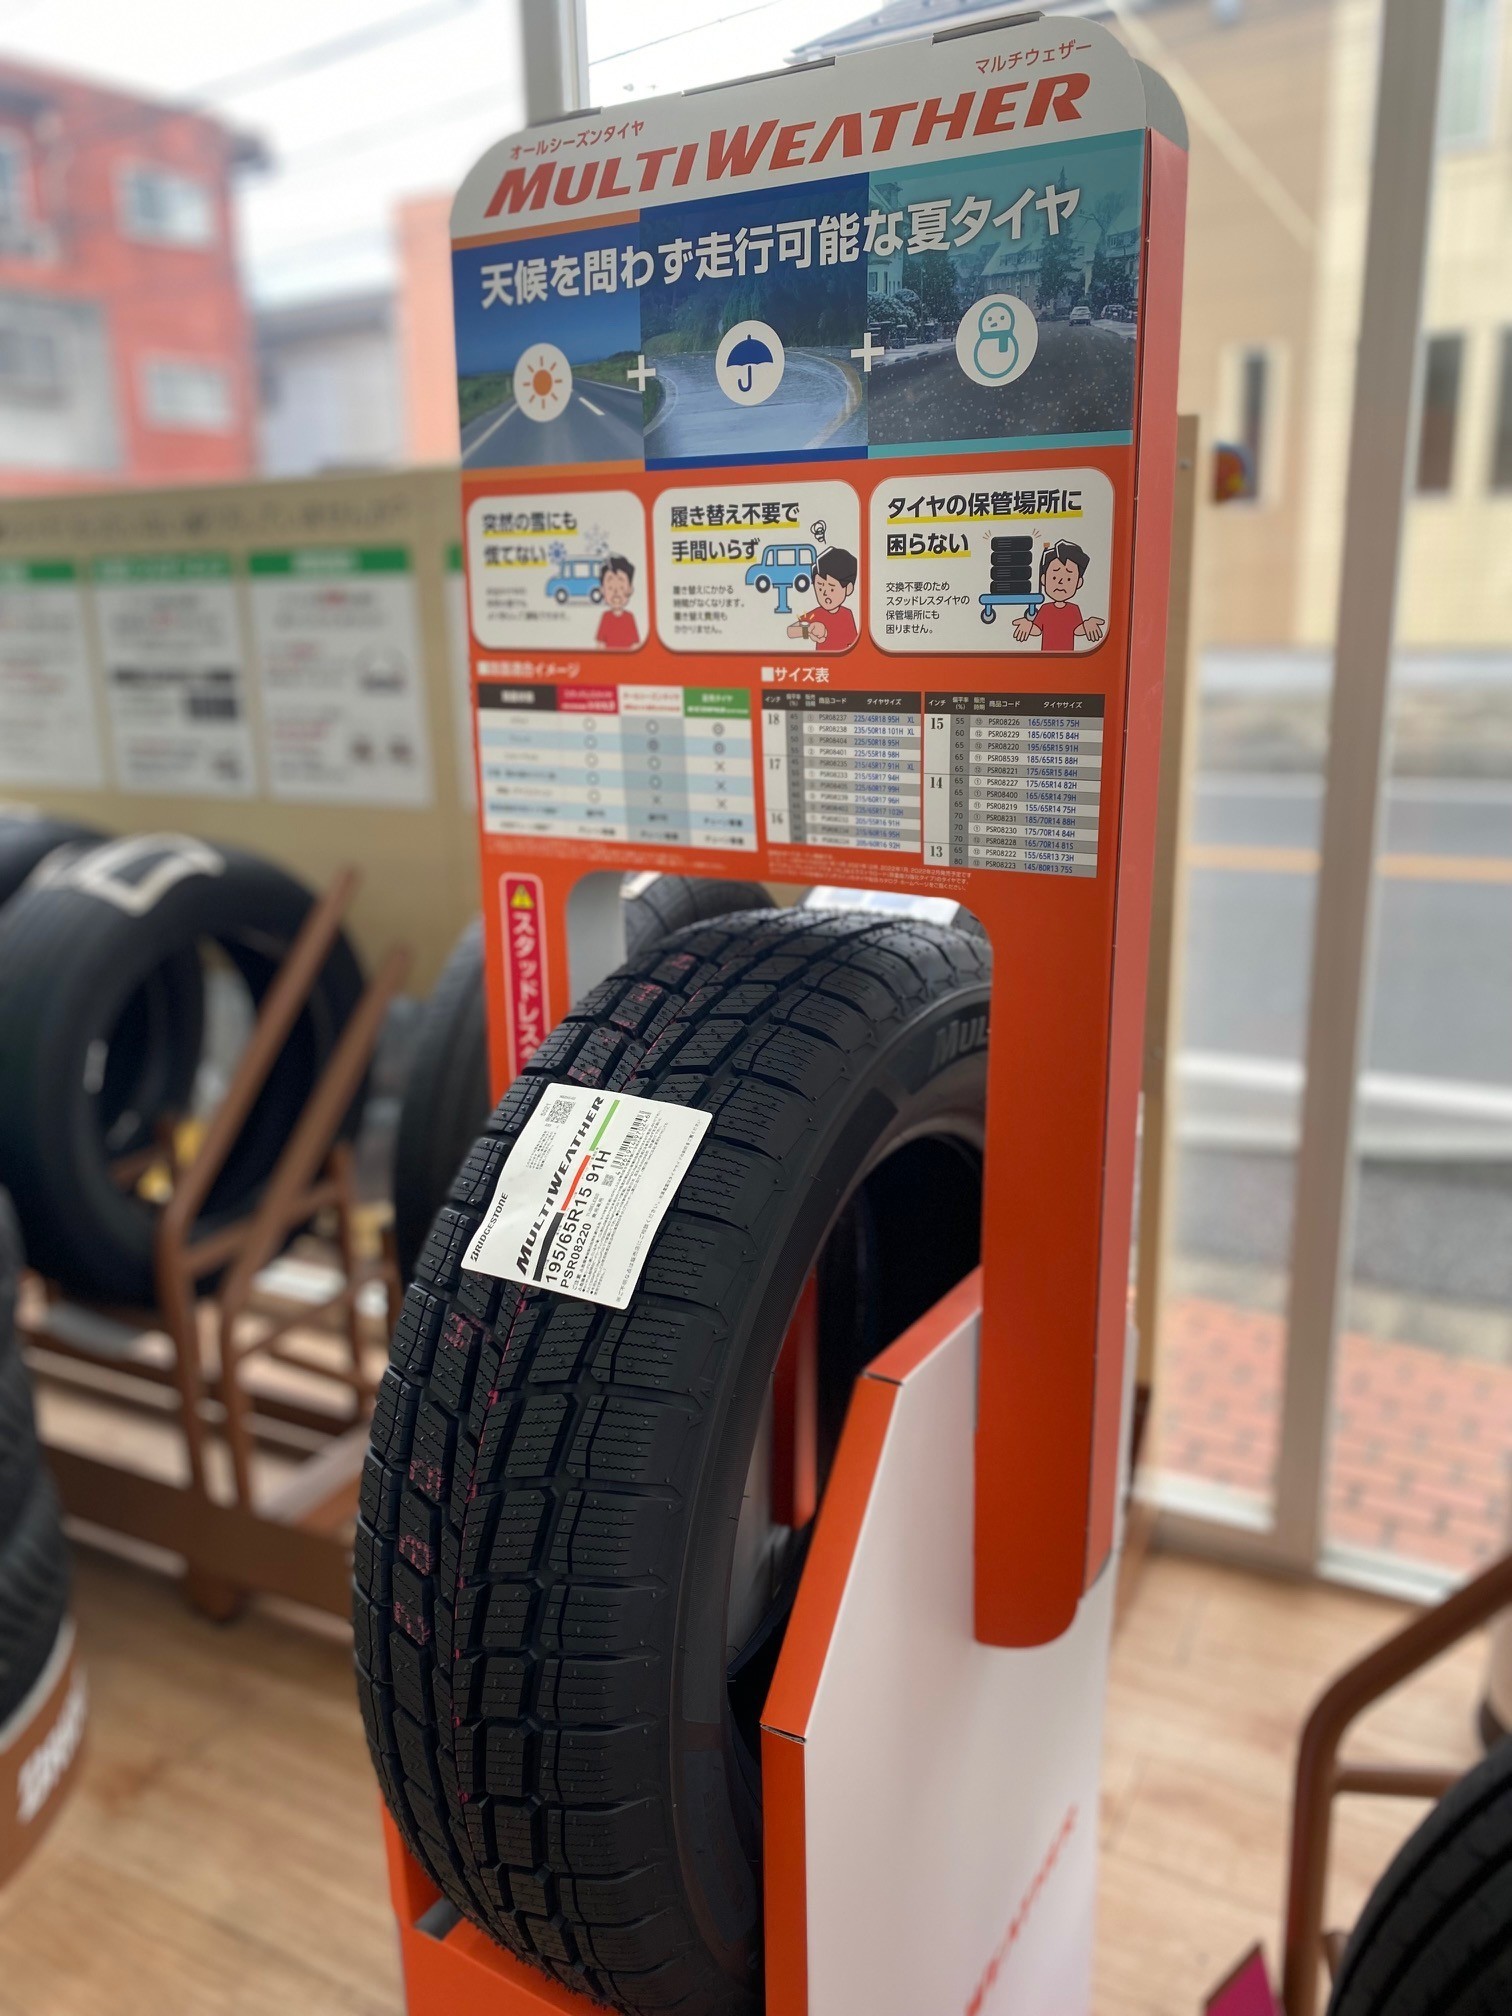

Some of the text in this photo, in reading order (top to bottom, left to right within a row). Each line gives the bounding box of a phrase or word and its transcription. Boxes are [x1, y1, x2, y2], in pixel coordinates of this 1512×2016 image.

[975, 42, 1092, 75] マルチウェザー
[510, 120, 645, 160] オールシーズンタイヤ
[480, 185, 1080, 309] 天候を問わず走行可能な夏タイヤ
[888, 489, 1082, 518] タイヤの保管場所に
[671, 502, 799, 528] 履き替え不要で
[672, 538, 760, 562] 手間いらず
[886, 532, 969, 556] 困らない
[885, 581, 950, 592] 交換不要のため
[886, 595, 969, 606] スタッドレスタイヤの
[885, 610, 940, 620] 保管場所にも
[885, 624, 933, 634] 困りません。
[989, 700, 1020, 708] 商品コード
[1043, 701, 1082, 709] タイヤサイズ
[768, 713, 780, 725] 18
[887, 715, 899, 723] 95H
[930, 717, 943, 730] 15
[988, 718, 1020, 726] PSR08226
[1066, 719, 1079, 727] 75H
[888, 727, 903, 735] 101H
[1028, 731, 1063, 739] 185/60R15
[1028, 743, 1063, 751] 195/65R15
[1065, 744, 1078, 752] 91H
[769, 758, 781, 770] 17
[987, 766, 1018, 774] PSR08221
[1027, 768, 1062, 776] 175/65R15
[930, 776, 942, 789] 14
[1026, 780, 1062, 788] 175/65R14
[1063, 781, 1077, 789] 82H
[986, 791, 1018, 799] PSR08400
[1026, 792, 1061, 800] 165/65R14
[1063, 793, 1076, 801] 79H
[986, 802, 1017, 810] PSR08219
[1026, 804, 1060, 812] 155/65R14
[986, 814, 1016, 822] PSR08231
[1025, 816, 1060, 824] 185/70R14
[1062, 818, 1075, 826] 88H
[986, 826, 1017, 834] PSR08230
[1025, 828, 1060, 836] 175/70R14
[1062, 829, 1075, 837] 84H
[986, 838, 1016, 846] PSR08228
[1061, 842, 1073, 850] 81S
[930, 845, 943, 857] 13
[985, 849, 1016, 857] PSR08222
[1024, 851, 1059, 859] 155/65R13
[1061, 853, 1074, 861] 73H
[985, 860, 1016, 869] PSR08223
[1024, 863, 1058, 872] 145/80R13
[1060, 865, 1072, 873] 75S
[546, 1149, 612, 1284] 195/65R15 91H
[470, 1192, 509, 1262] BRIDGESTONE
[560, 1222, 592, 1288] PSR08220
